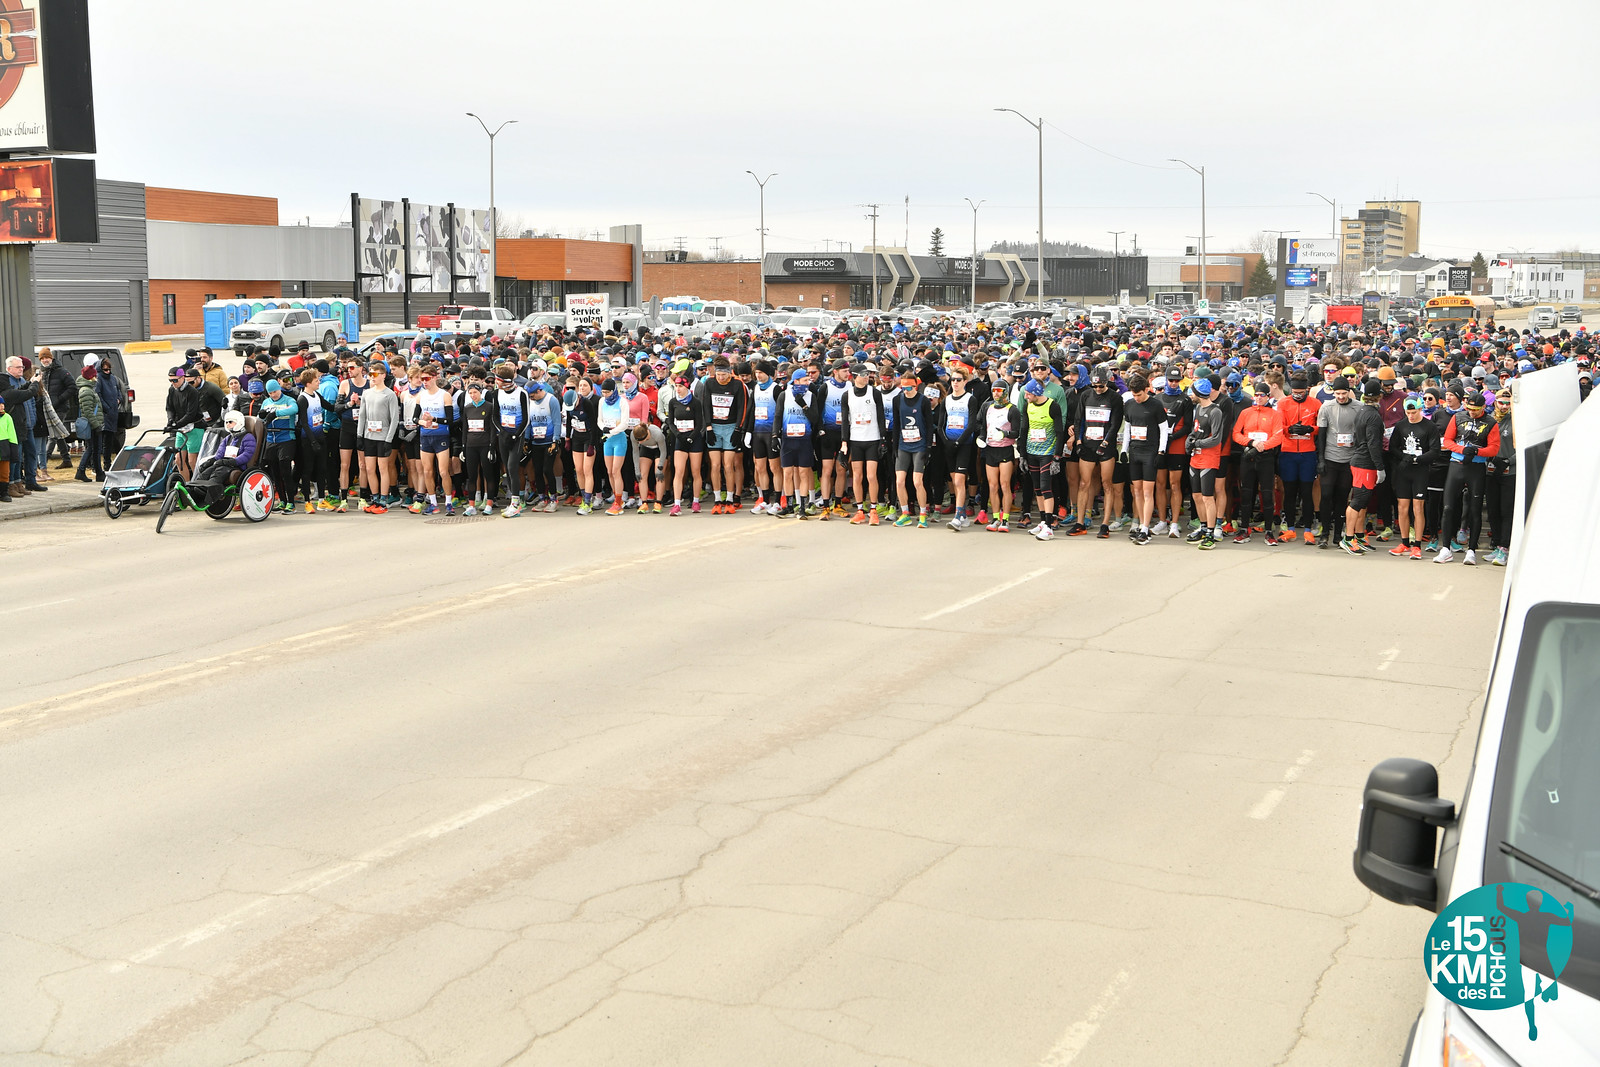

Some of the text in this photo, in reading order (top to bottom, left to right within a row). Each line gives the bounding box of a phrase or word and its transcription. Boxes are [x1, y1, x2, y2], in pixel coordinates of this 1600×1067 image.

[954, 260, 980, 271] MODE CHC
[571, 307, 601, 316] Service
